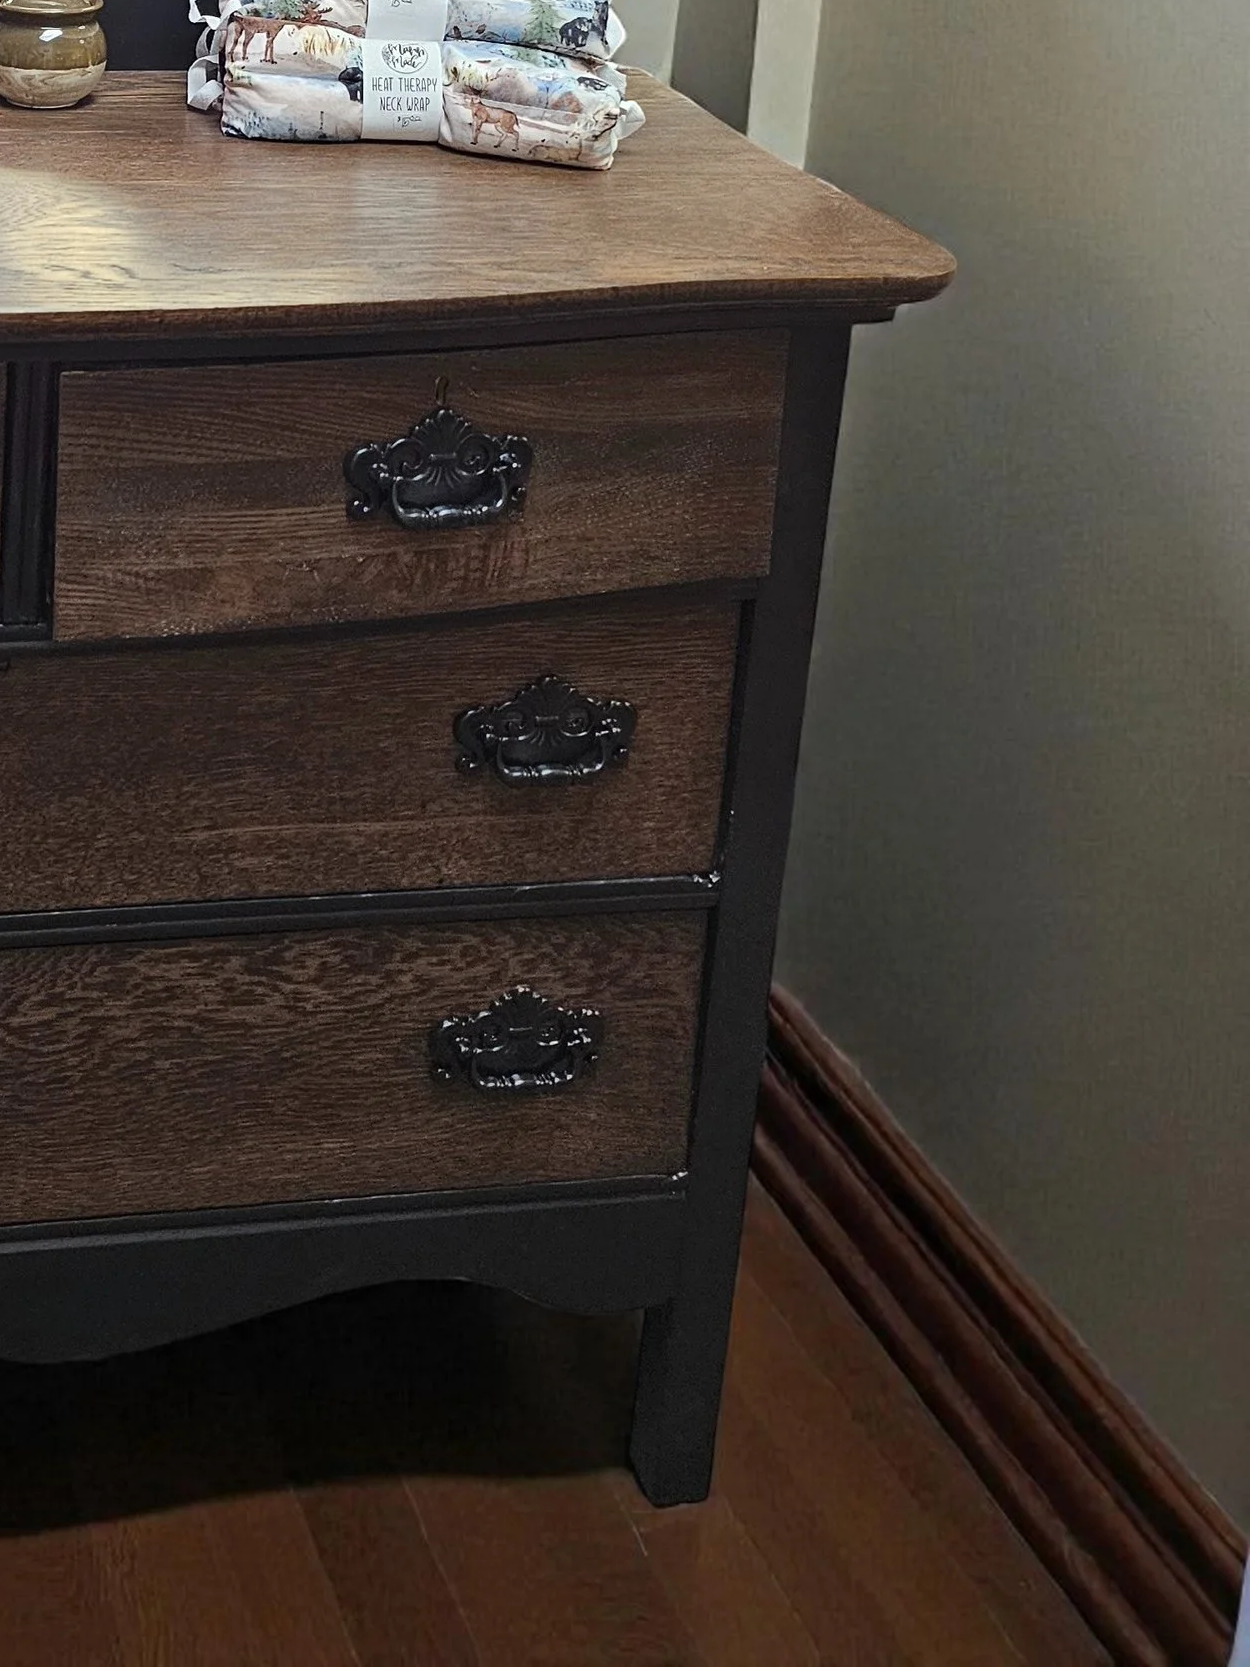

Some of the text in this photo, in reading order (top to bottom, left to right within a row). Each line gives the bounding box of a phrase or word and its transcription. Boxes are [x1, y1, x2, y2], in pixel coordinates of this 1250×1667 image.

[371, 76, 438, 92] HEAT THERAPY
[379, 96, 431, 111] NECK WRAP
